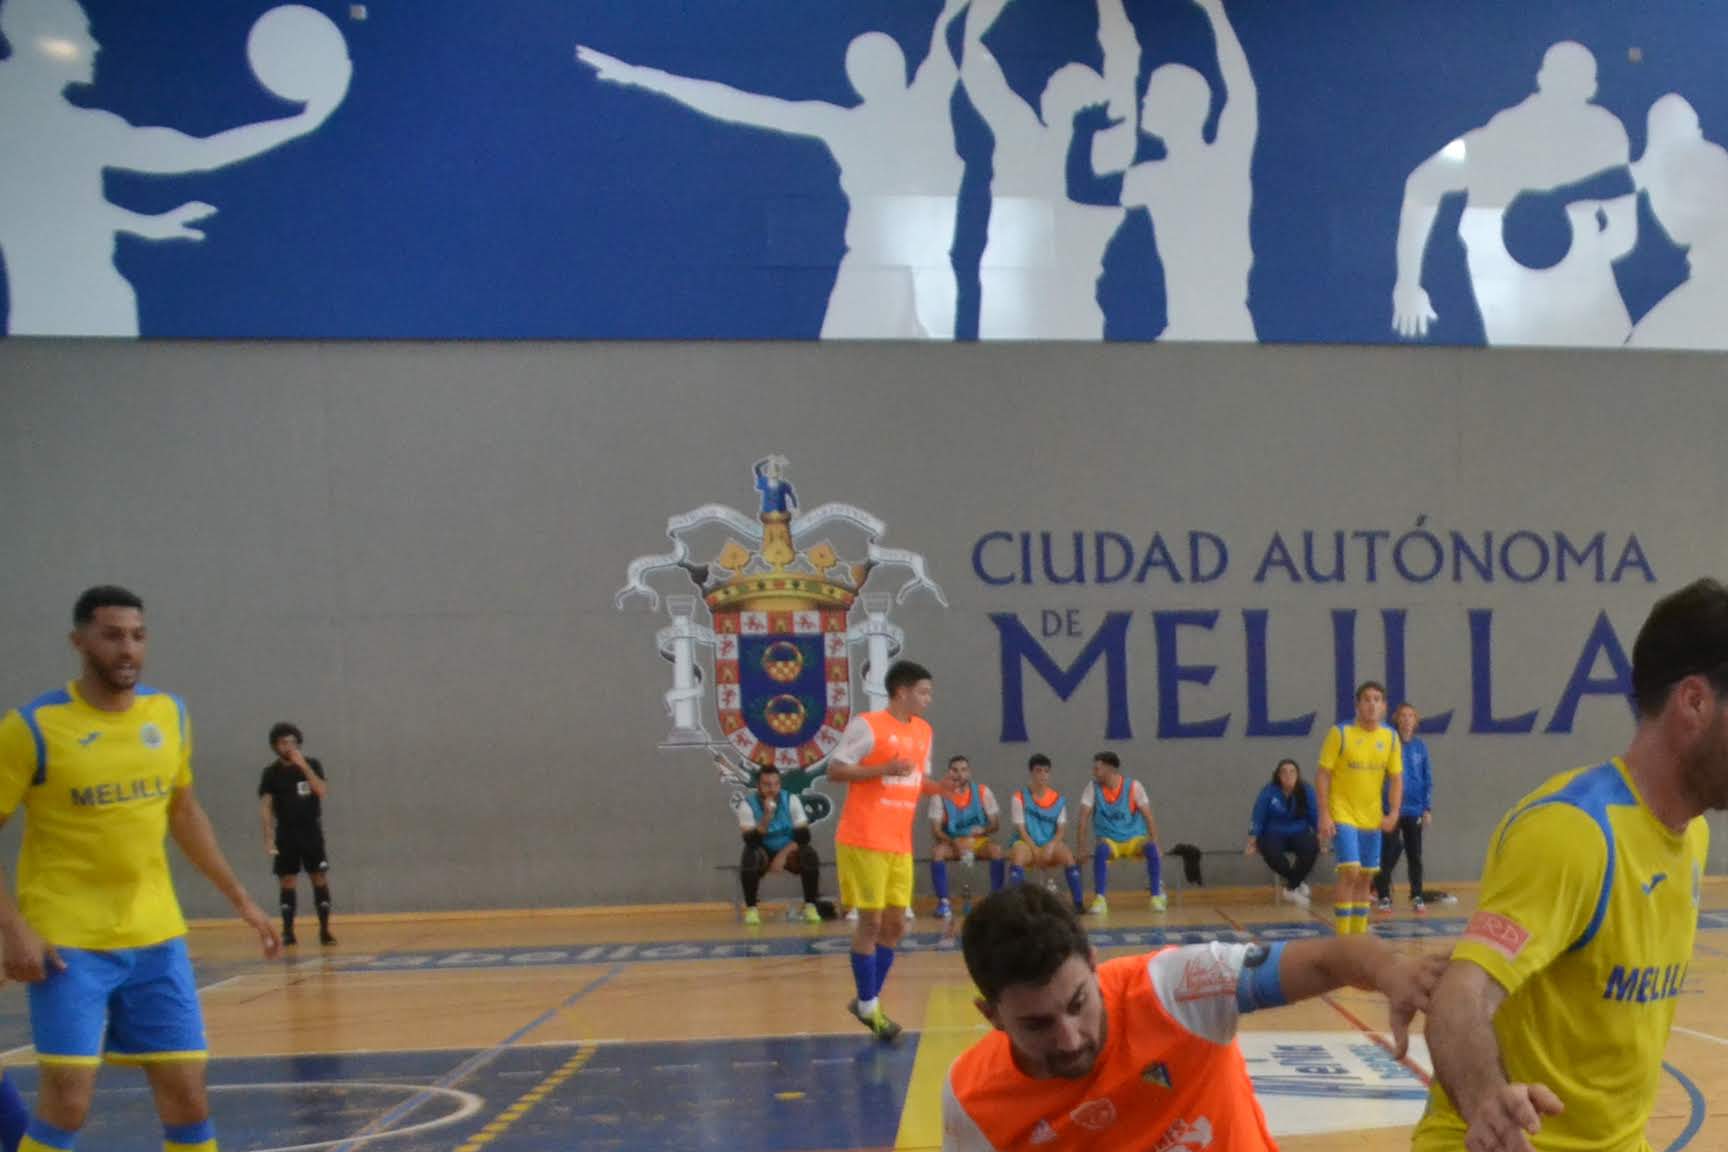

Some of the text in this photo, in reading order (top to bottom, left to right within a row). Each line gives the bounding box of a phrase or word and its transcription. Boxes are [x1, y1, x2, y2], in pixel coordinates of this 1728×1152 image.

[972, 515, 1658, 584] CIUDAD AUTÓNOMA
[1042, 609, 1083, 638] DE
[987, 609, 1643, 743] MELILLA
